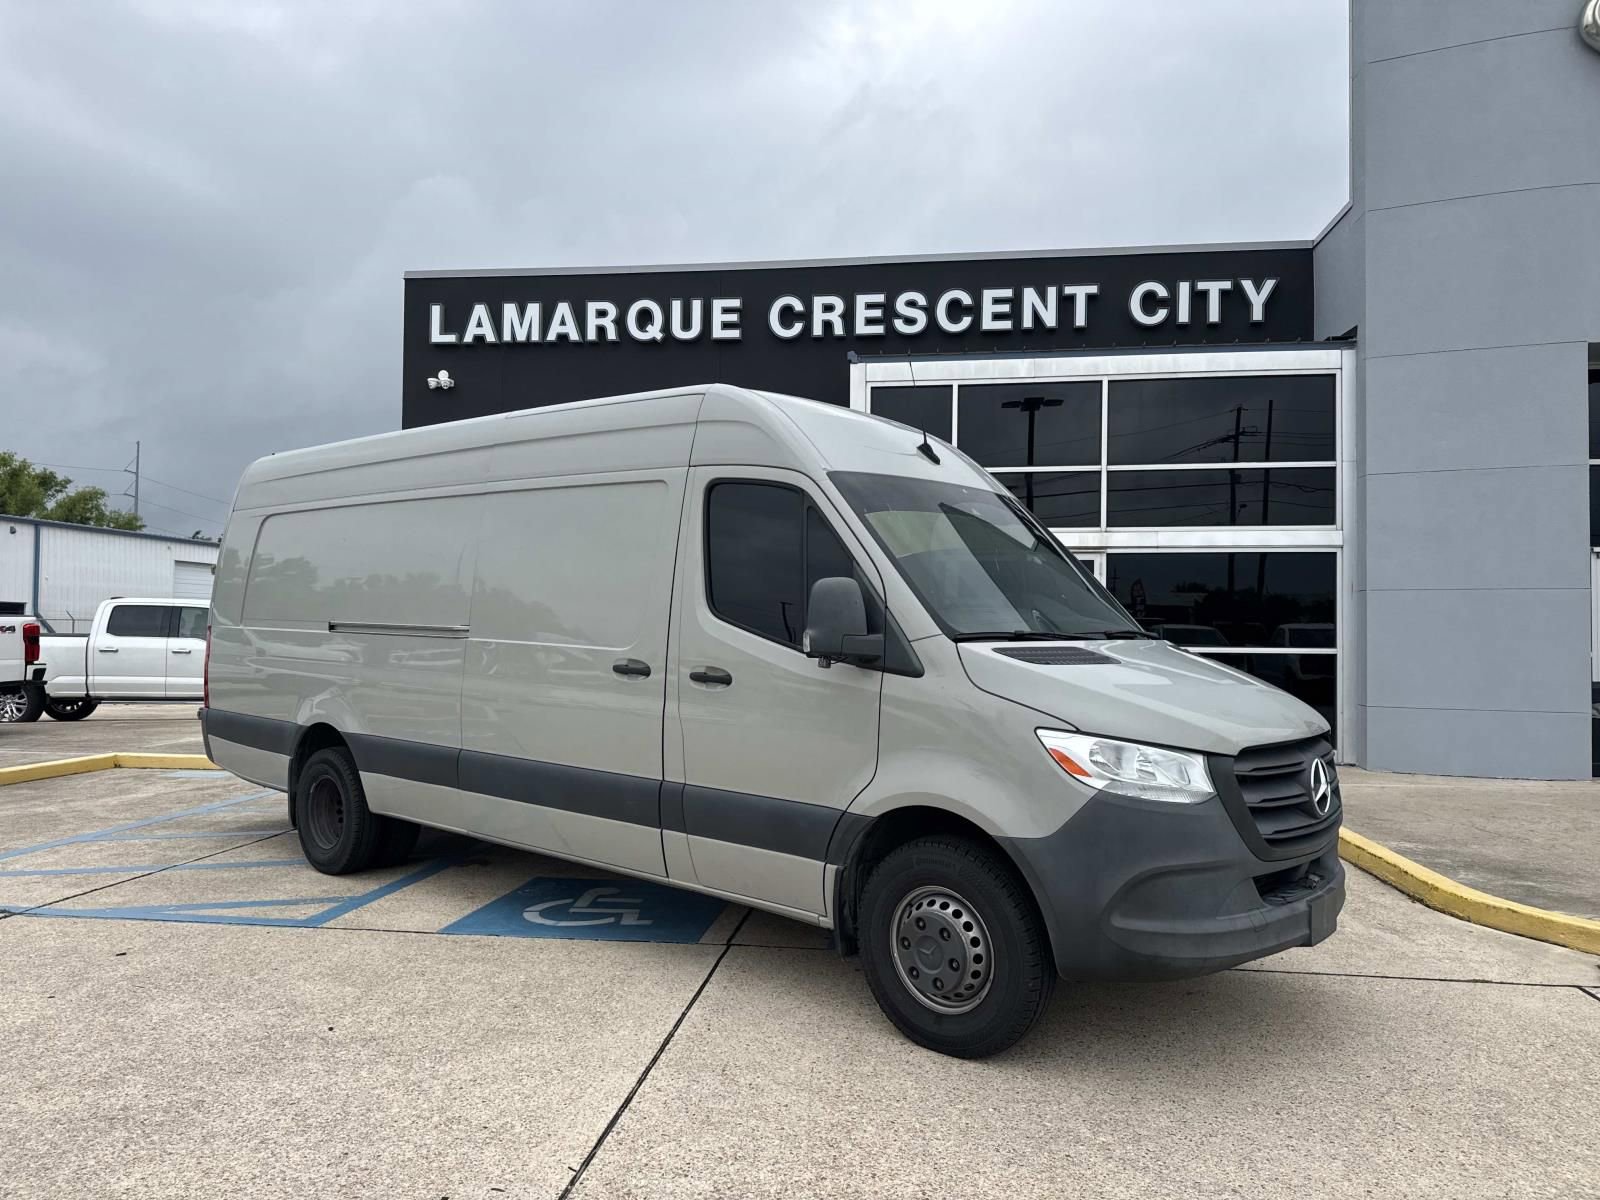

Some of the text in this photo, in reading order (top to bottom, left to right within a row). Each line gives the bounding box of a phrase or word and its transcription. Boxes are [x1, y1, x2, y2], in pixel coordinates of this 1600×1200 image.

[429, 278, 1279, 344] LAMARQUE CRESCENT CITY
